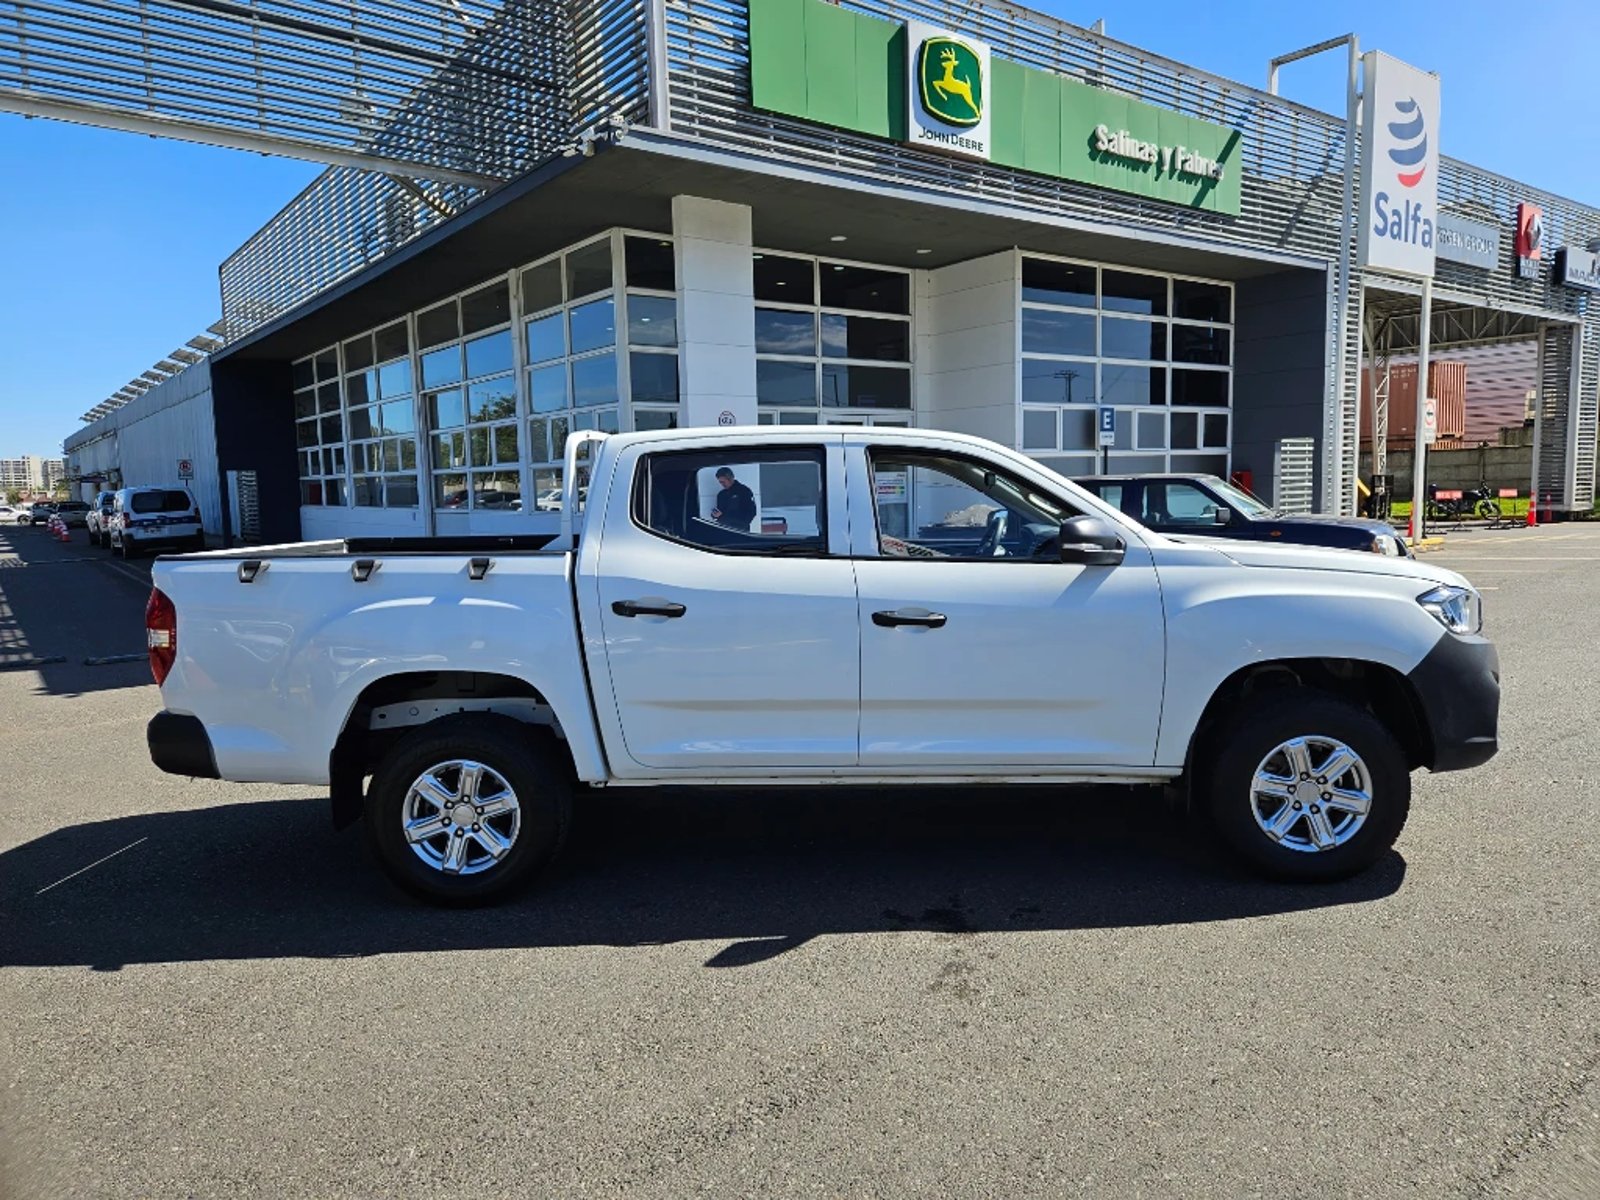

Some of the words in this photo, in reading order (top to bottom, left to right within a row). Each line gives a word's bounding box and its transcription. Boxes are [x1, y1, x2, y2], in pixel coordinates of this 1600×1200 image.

[918, 126, 949, 143] JOHN
[951, 133, 984, 152] DEERE
[1094, 123, 1159, 163] Salinas
[1162, 146, 1174, 171] y
[1373, 191, 1434, 249] Salfa
[1103, 411, 1112, 429] E
